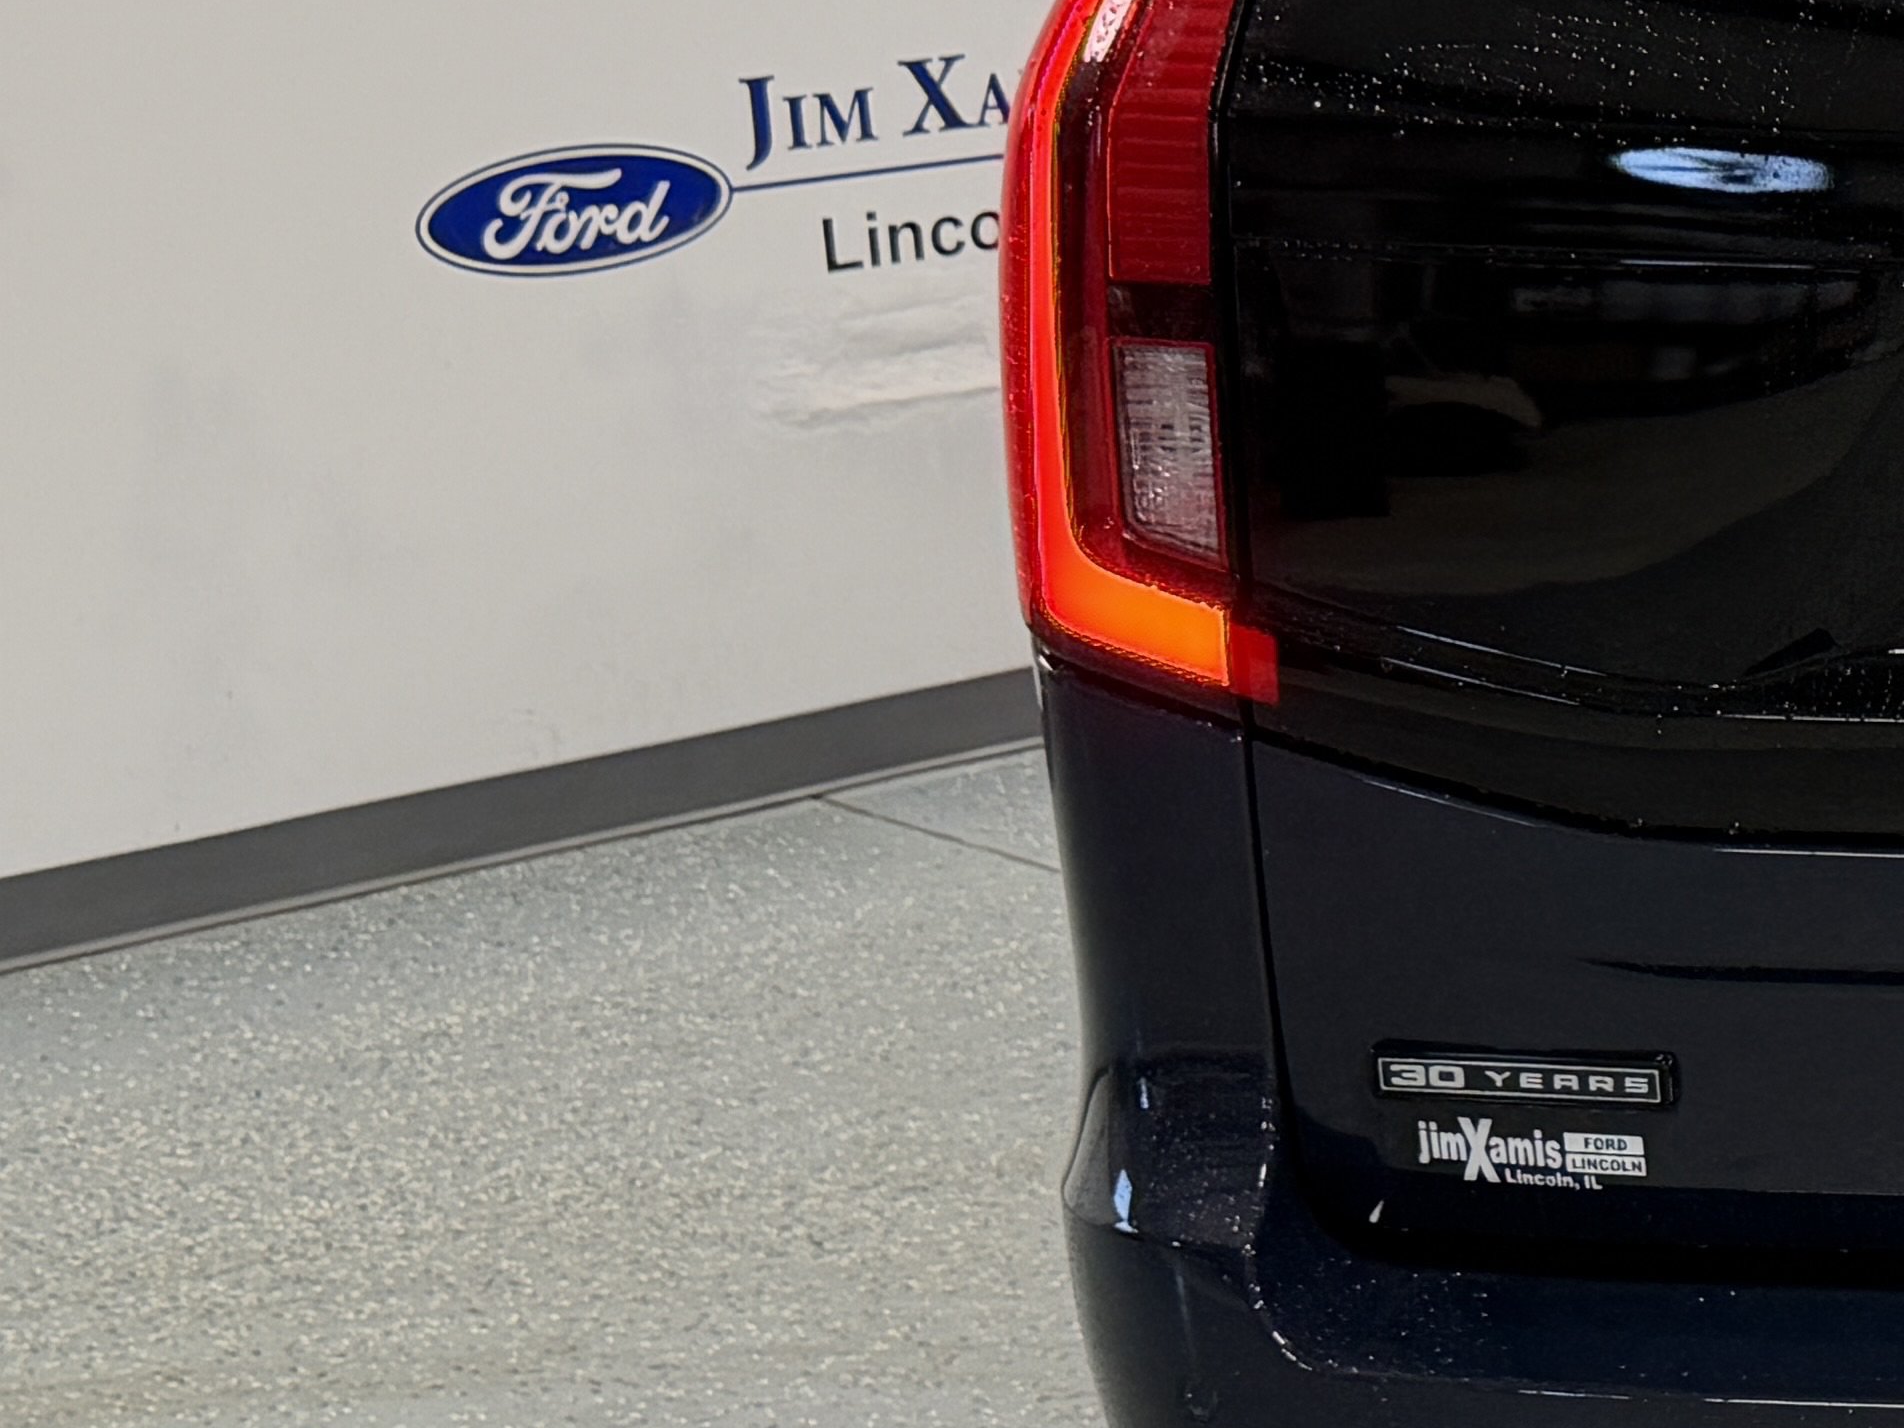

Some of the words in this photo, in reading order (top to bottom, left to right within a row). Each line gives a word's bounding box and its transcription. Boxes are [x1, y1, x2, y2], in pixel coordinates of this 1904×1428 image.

[482, 168, 670, 260] Ford
[1389, 1064, 1465, 1088] 30
[1485, 1071, 1649, 1093] YEARS
[1584, 1137, 1628, 1152] FORD
[1571, 1157, 1642, 1173] LINCOLN
[1504, 1168, 1581, 1191] Lincoln,
[1584, 1175, 1603, 1190] IL
